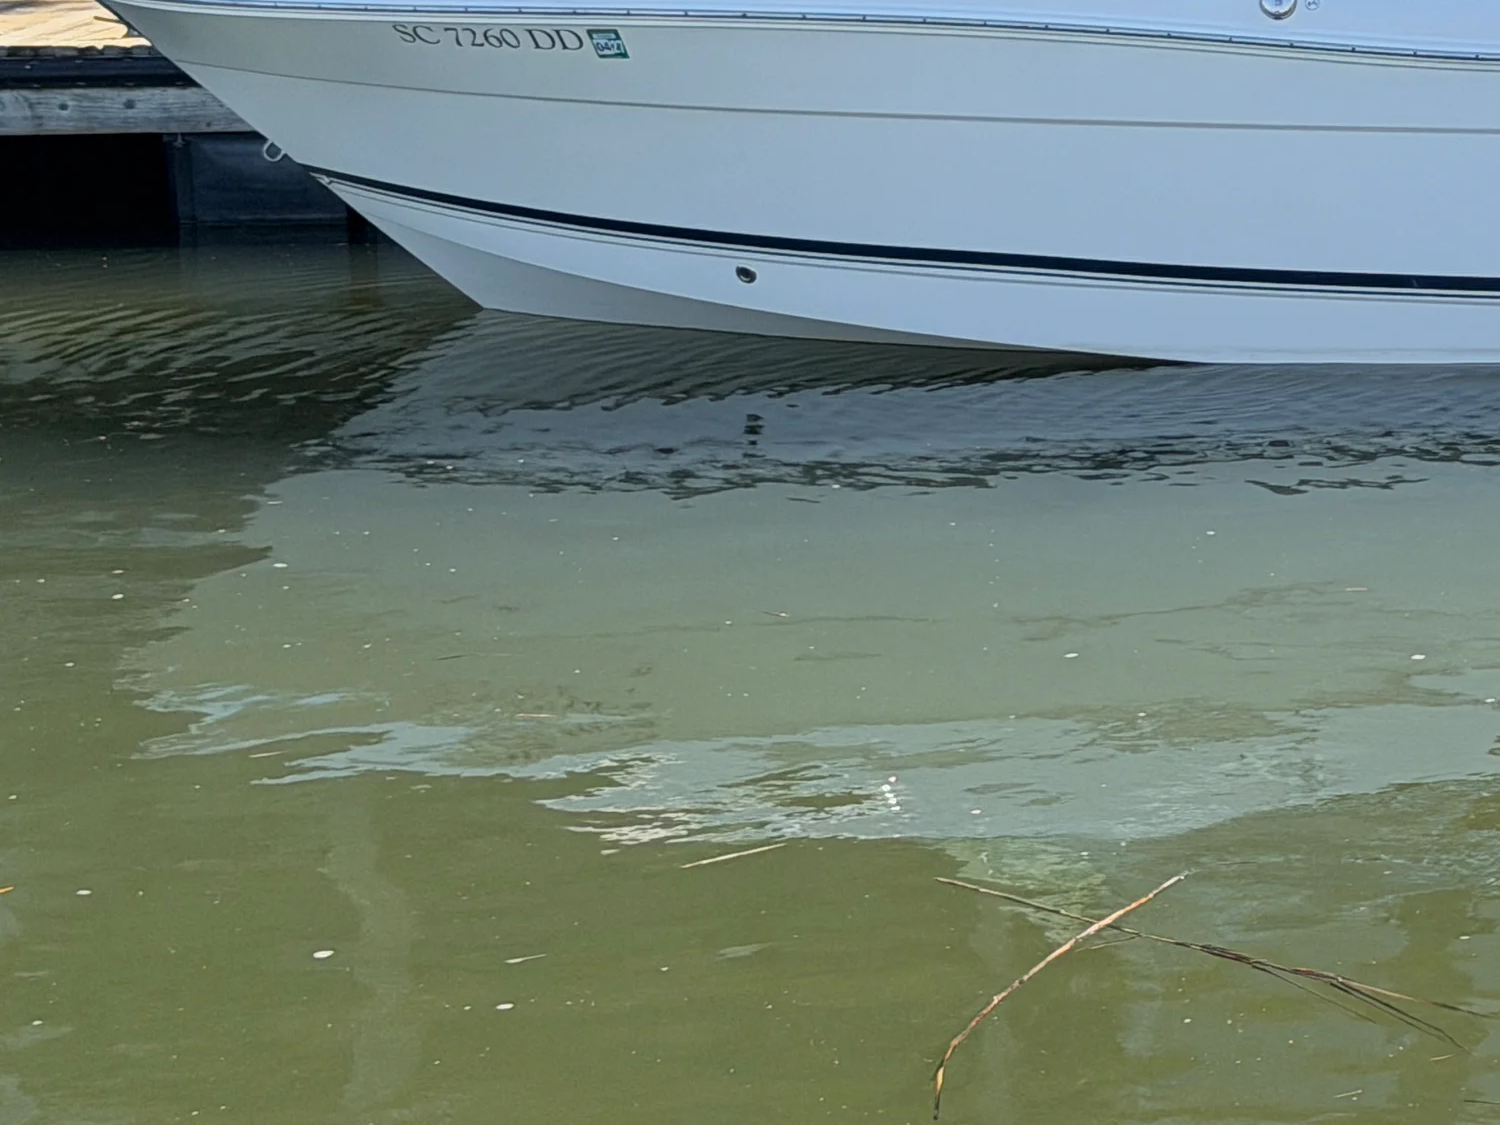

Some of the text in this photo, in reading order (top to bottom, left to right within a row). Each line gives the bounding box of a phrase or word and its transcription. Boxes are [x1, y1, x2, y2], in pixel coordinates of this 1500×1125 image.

[392, 24, 584, 51] SC 7260 DD
